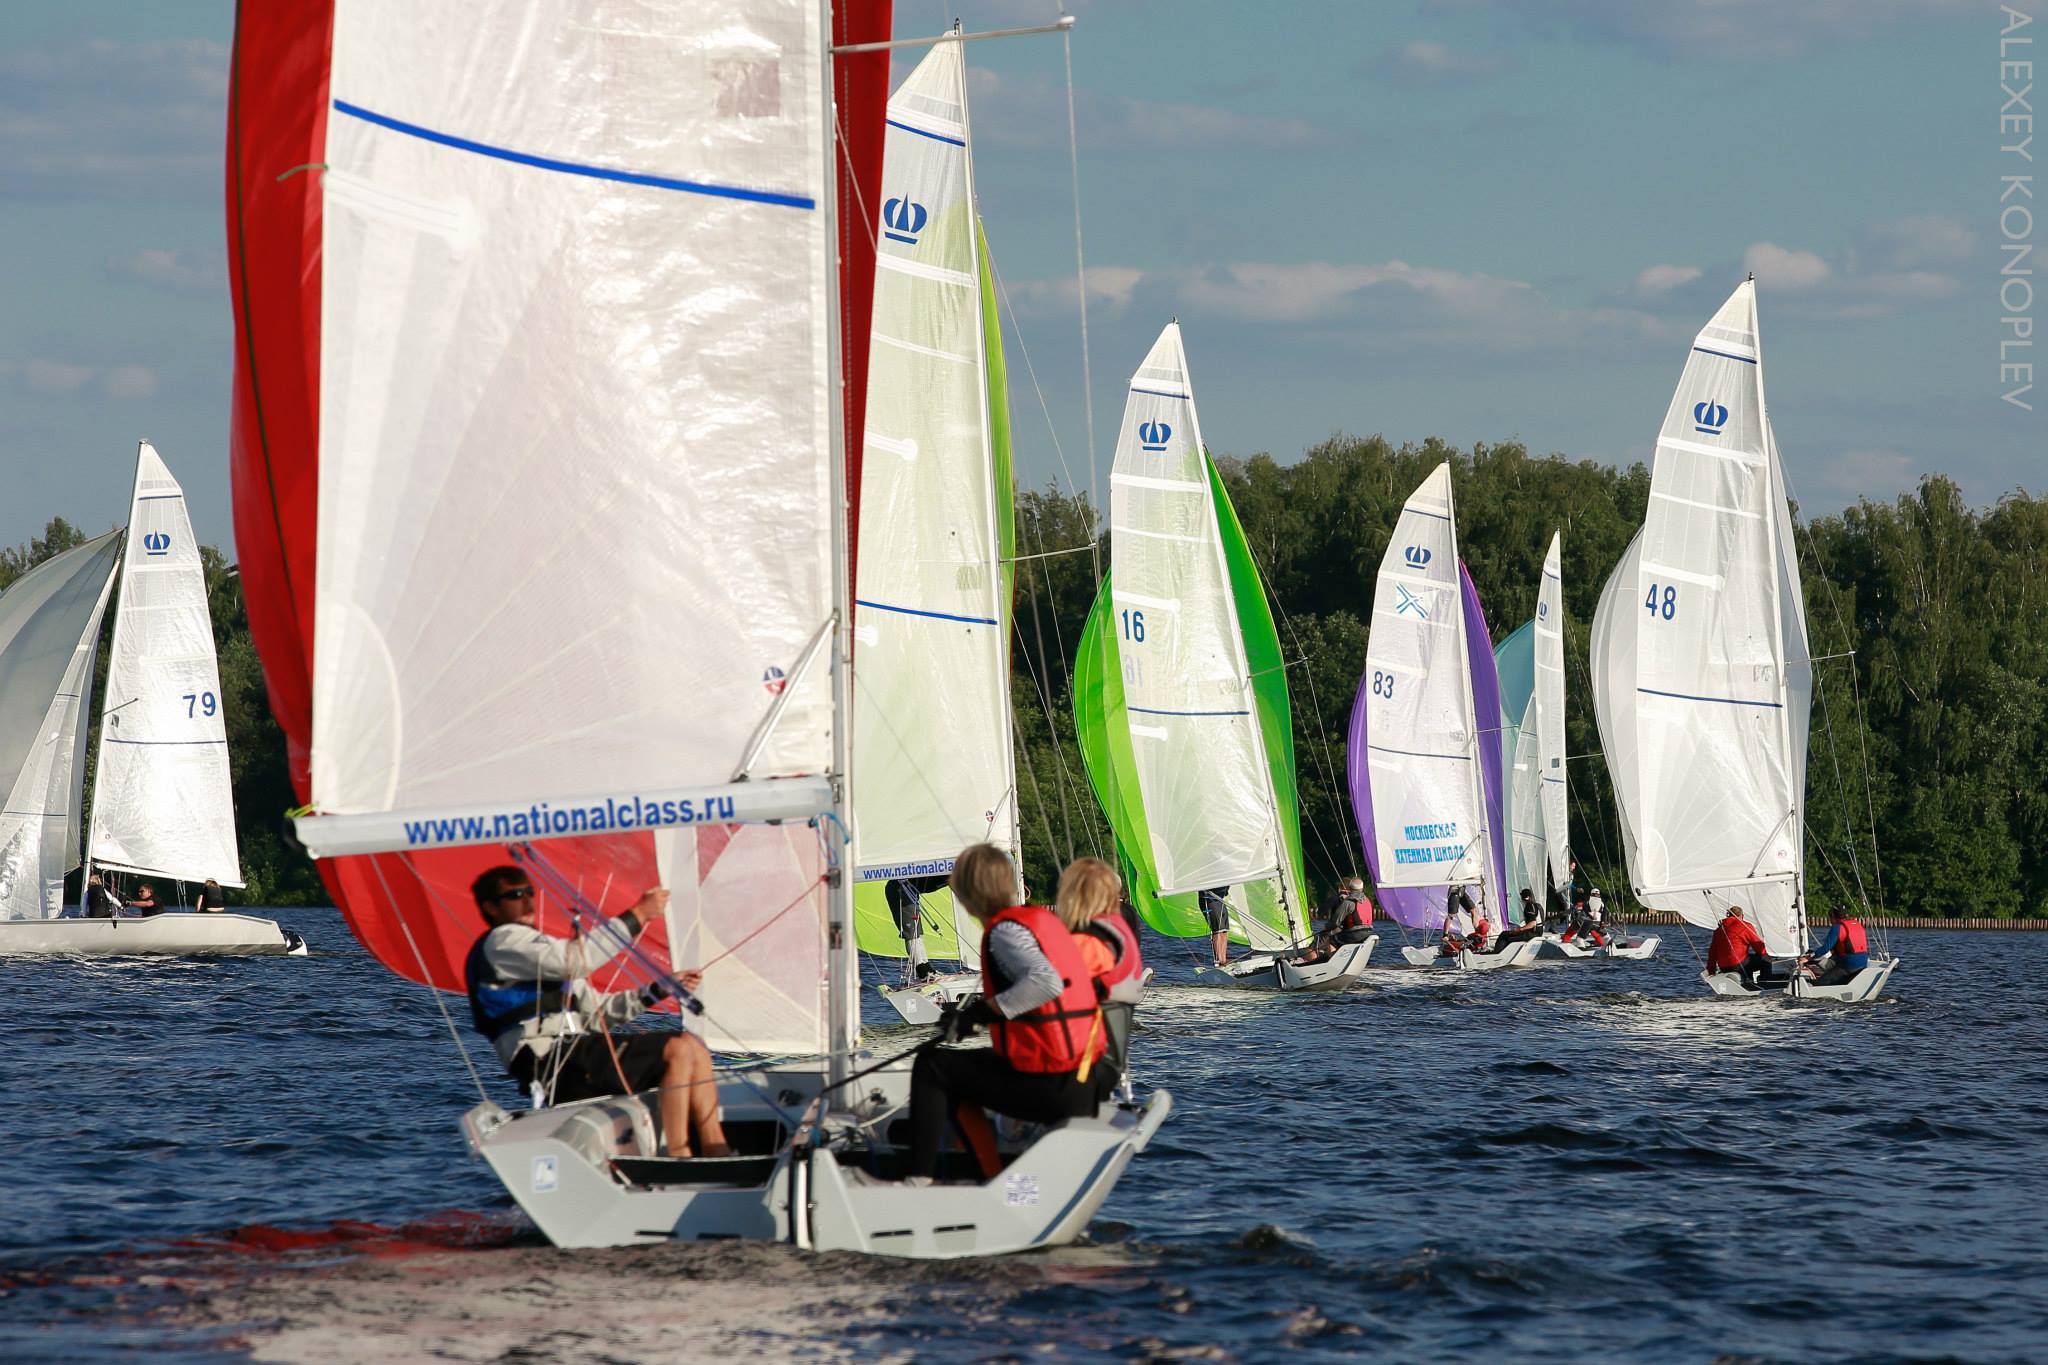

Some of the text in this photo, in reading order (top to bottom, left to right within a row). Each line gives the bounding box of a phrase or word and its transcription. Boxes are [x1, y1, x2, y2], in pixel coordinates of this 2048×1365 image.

[1645, 583, 1676, 620] 48
[1122, 609, 1145, 642] 16
[1373, 671, 1394, 699] 83
[182, 691, 216, 718] 79
[404, 796, 734, 844] www.nationalclass.ru
[1404, 822, 1457, 840] МОСКОВСКАЯ
